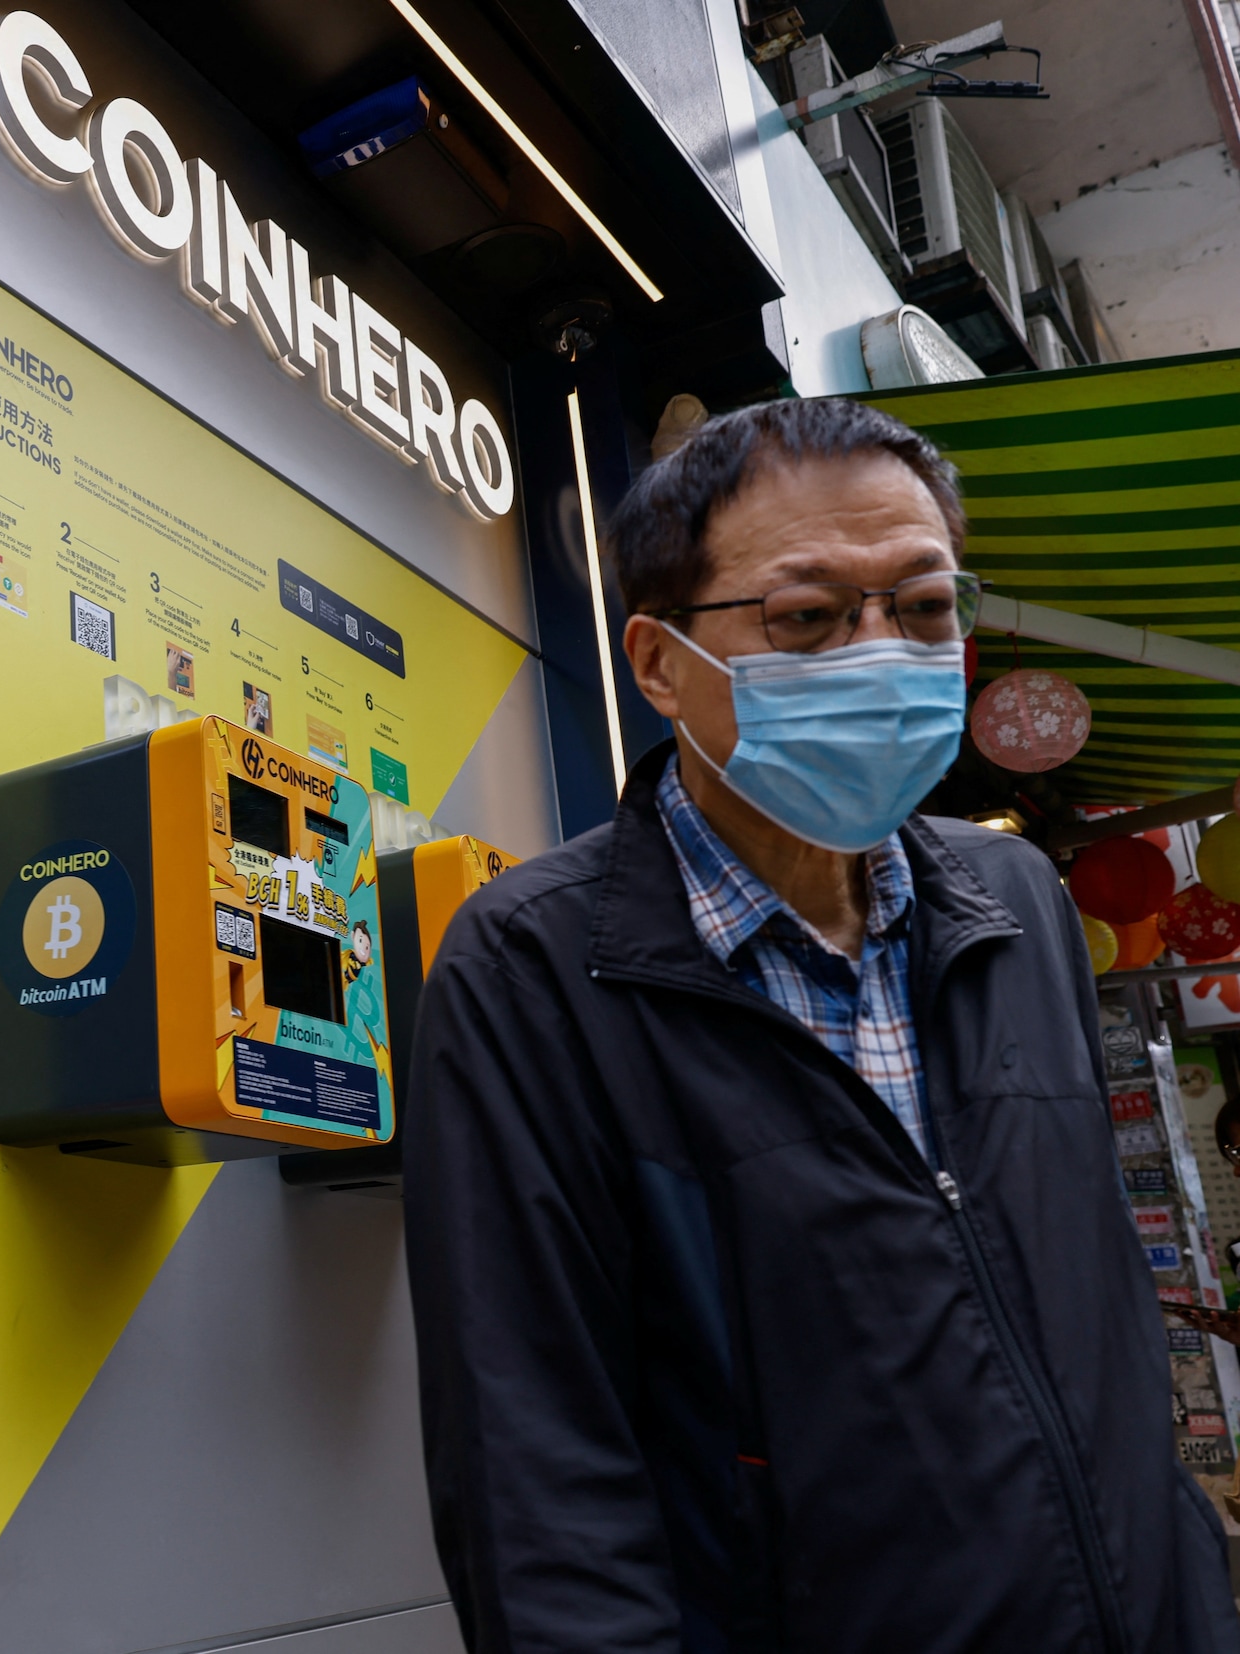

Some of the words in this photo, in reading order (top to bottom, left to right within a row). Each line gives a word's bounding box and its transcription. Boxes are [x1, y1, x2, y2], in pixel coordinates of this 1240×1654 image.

[26, 381, 34, 391] Be
[35, 386, 51, 401] brave
[51, 397, 58, 407] to
[58, 401, 74, 417] trade.
[7, 534, 15, 543] you
[16, 539, 31, 551] would
[60, 522, 71, 545] 2
[10, 543, 18, 552] the
[19, 548, 30, 558] icon
[56, 561, 68, 572] Press
[94, 583, 103, 591] your
[150, 572, 160, 593] 3
[231, 618, 240, 637] 4
[301, 655, 309, 675] 5
[365, 692, 373, 711] 6
[267, 757, 339, 805] COINHERO
[19, 850, 110, 882] COINHERO
[246, 872, 282, 909] BCH
[286, 870, 310, 920] 1%
[280, 1018, 322, 1046] bitcoin
